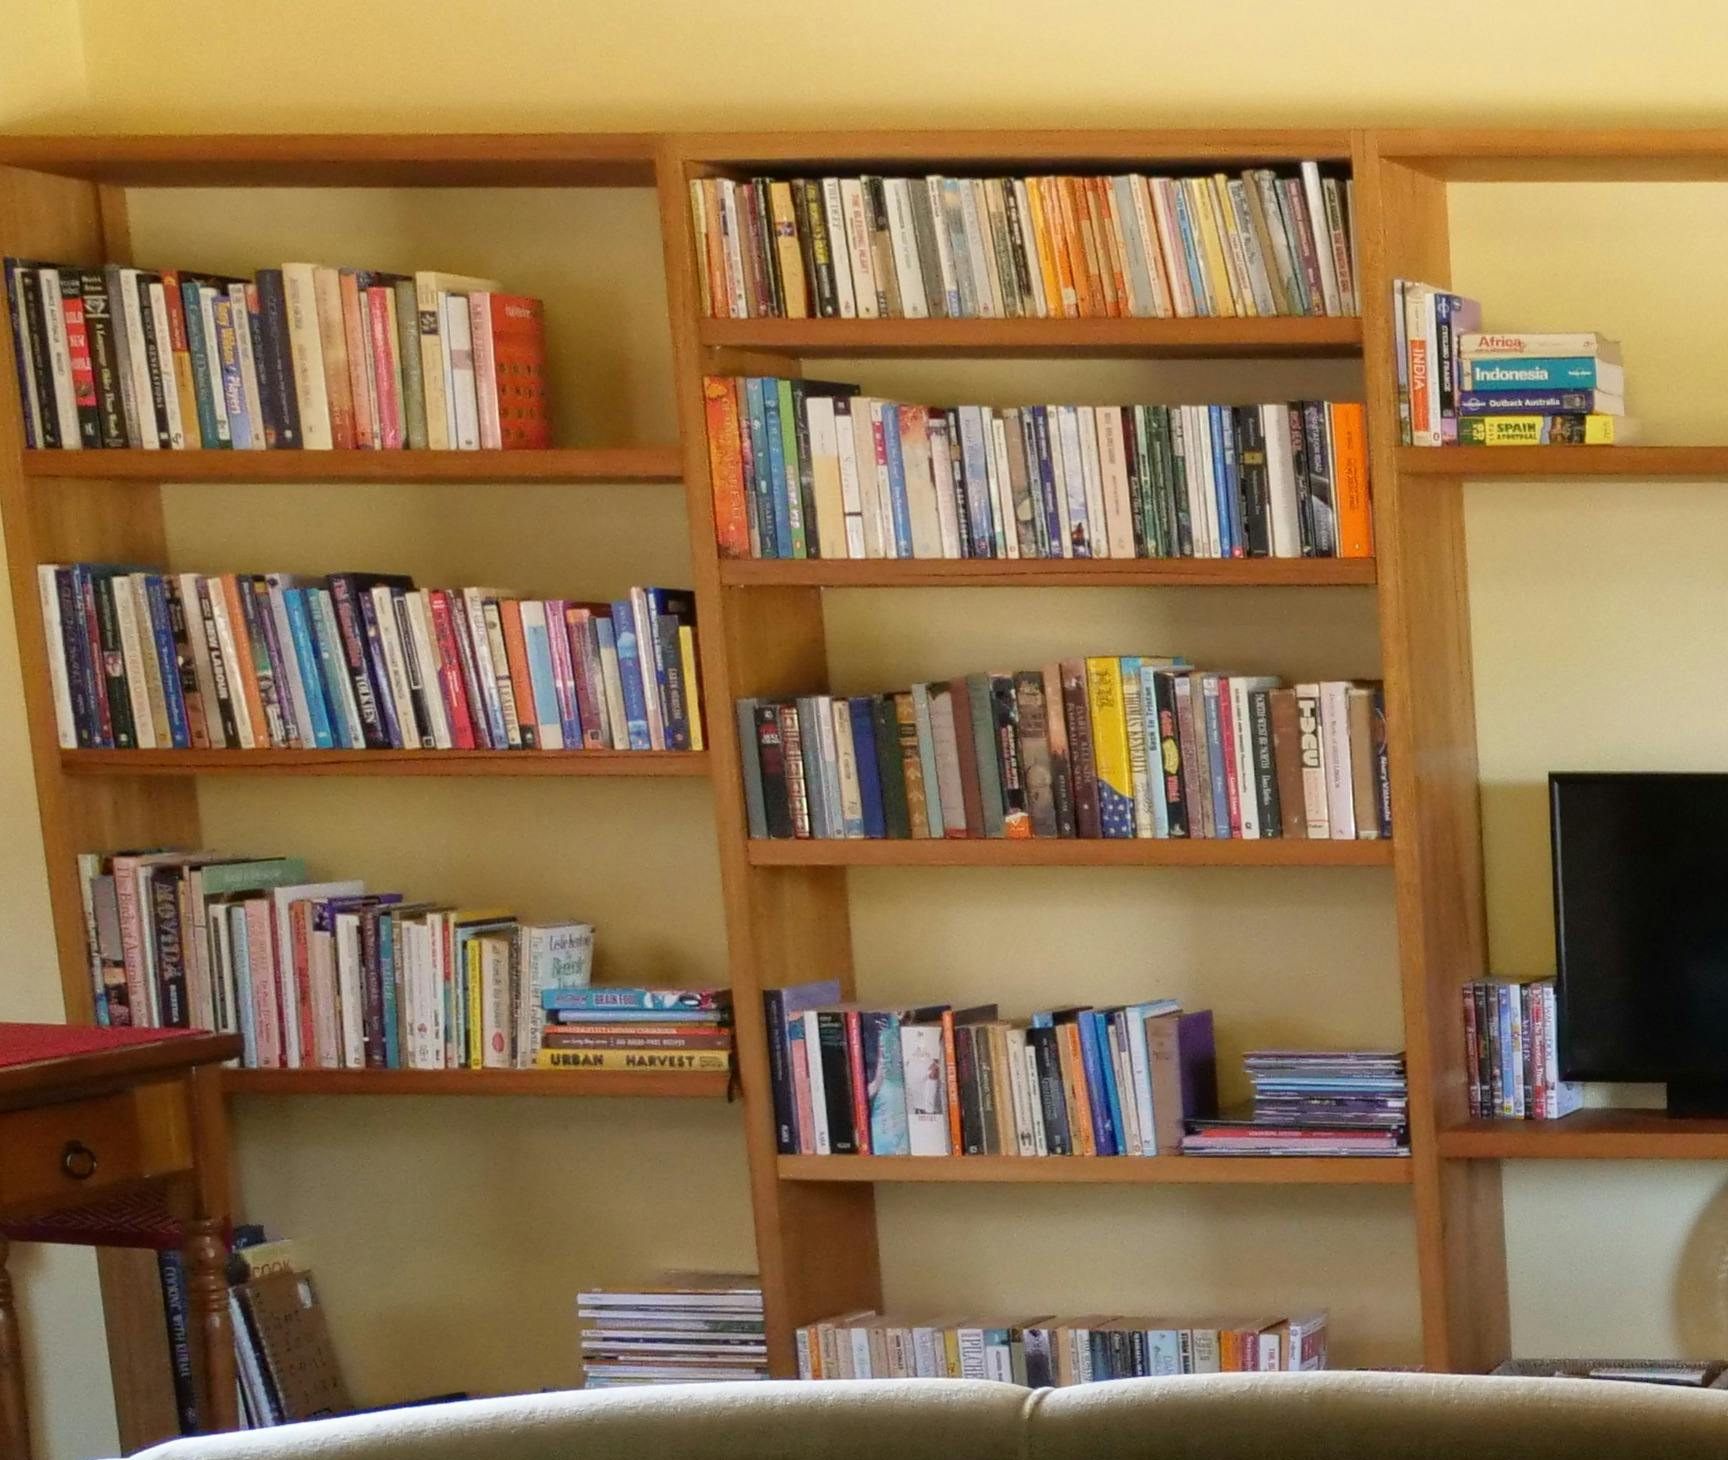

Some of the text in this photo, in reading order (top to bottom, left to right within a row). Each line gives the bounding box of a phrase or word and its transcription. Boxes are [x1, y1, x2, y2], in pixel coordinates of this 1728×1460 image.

[1478, 336, 1521, 349] Africa
[1412, 349, 1425, 390] INDIA
[1475, 367, 1549, 381] Indonesia
[226, 375, 243, 415] Players
[1489, 397, 1560, 408] Outback Australia
[1496, 423, 1536, 432] SPAIN
[204, 620, 229, 699] NEW LABOUR
[355, 675, 377, 723] TOLKIEN
[1125, 693, 1148, 775] THOMAS KENEALLY
[119, 892, 134, 922] Birds
[154, 881, 182, 981] MOVIDA
[126, 942, 142, 996] Australia
[550, 1054, 694, 1068] URBAN HARVEST
[961, 1339, 984, 1379] PILCHE
